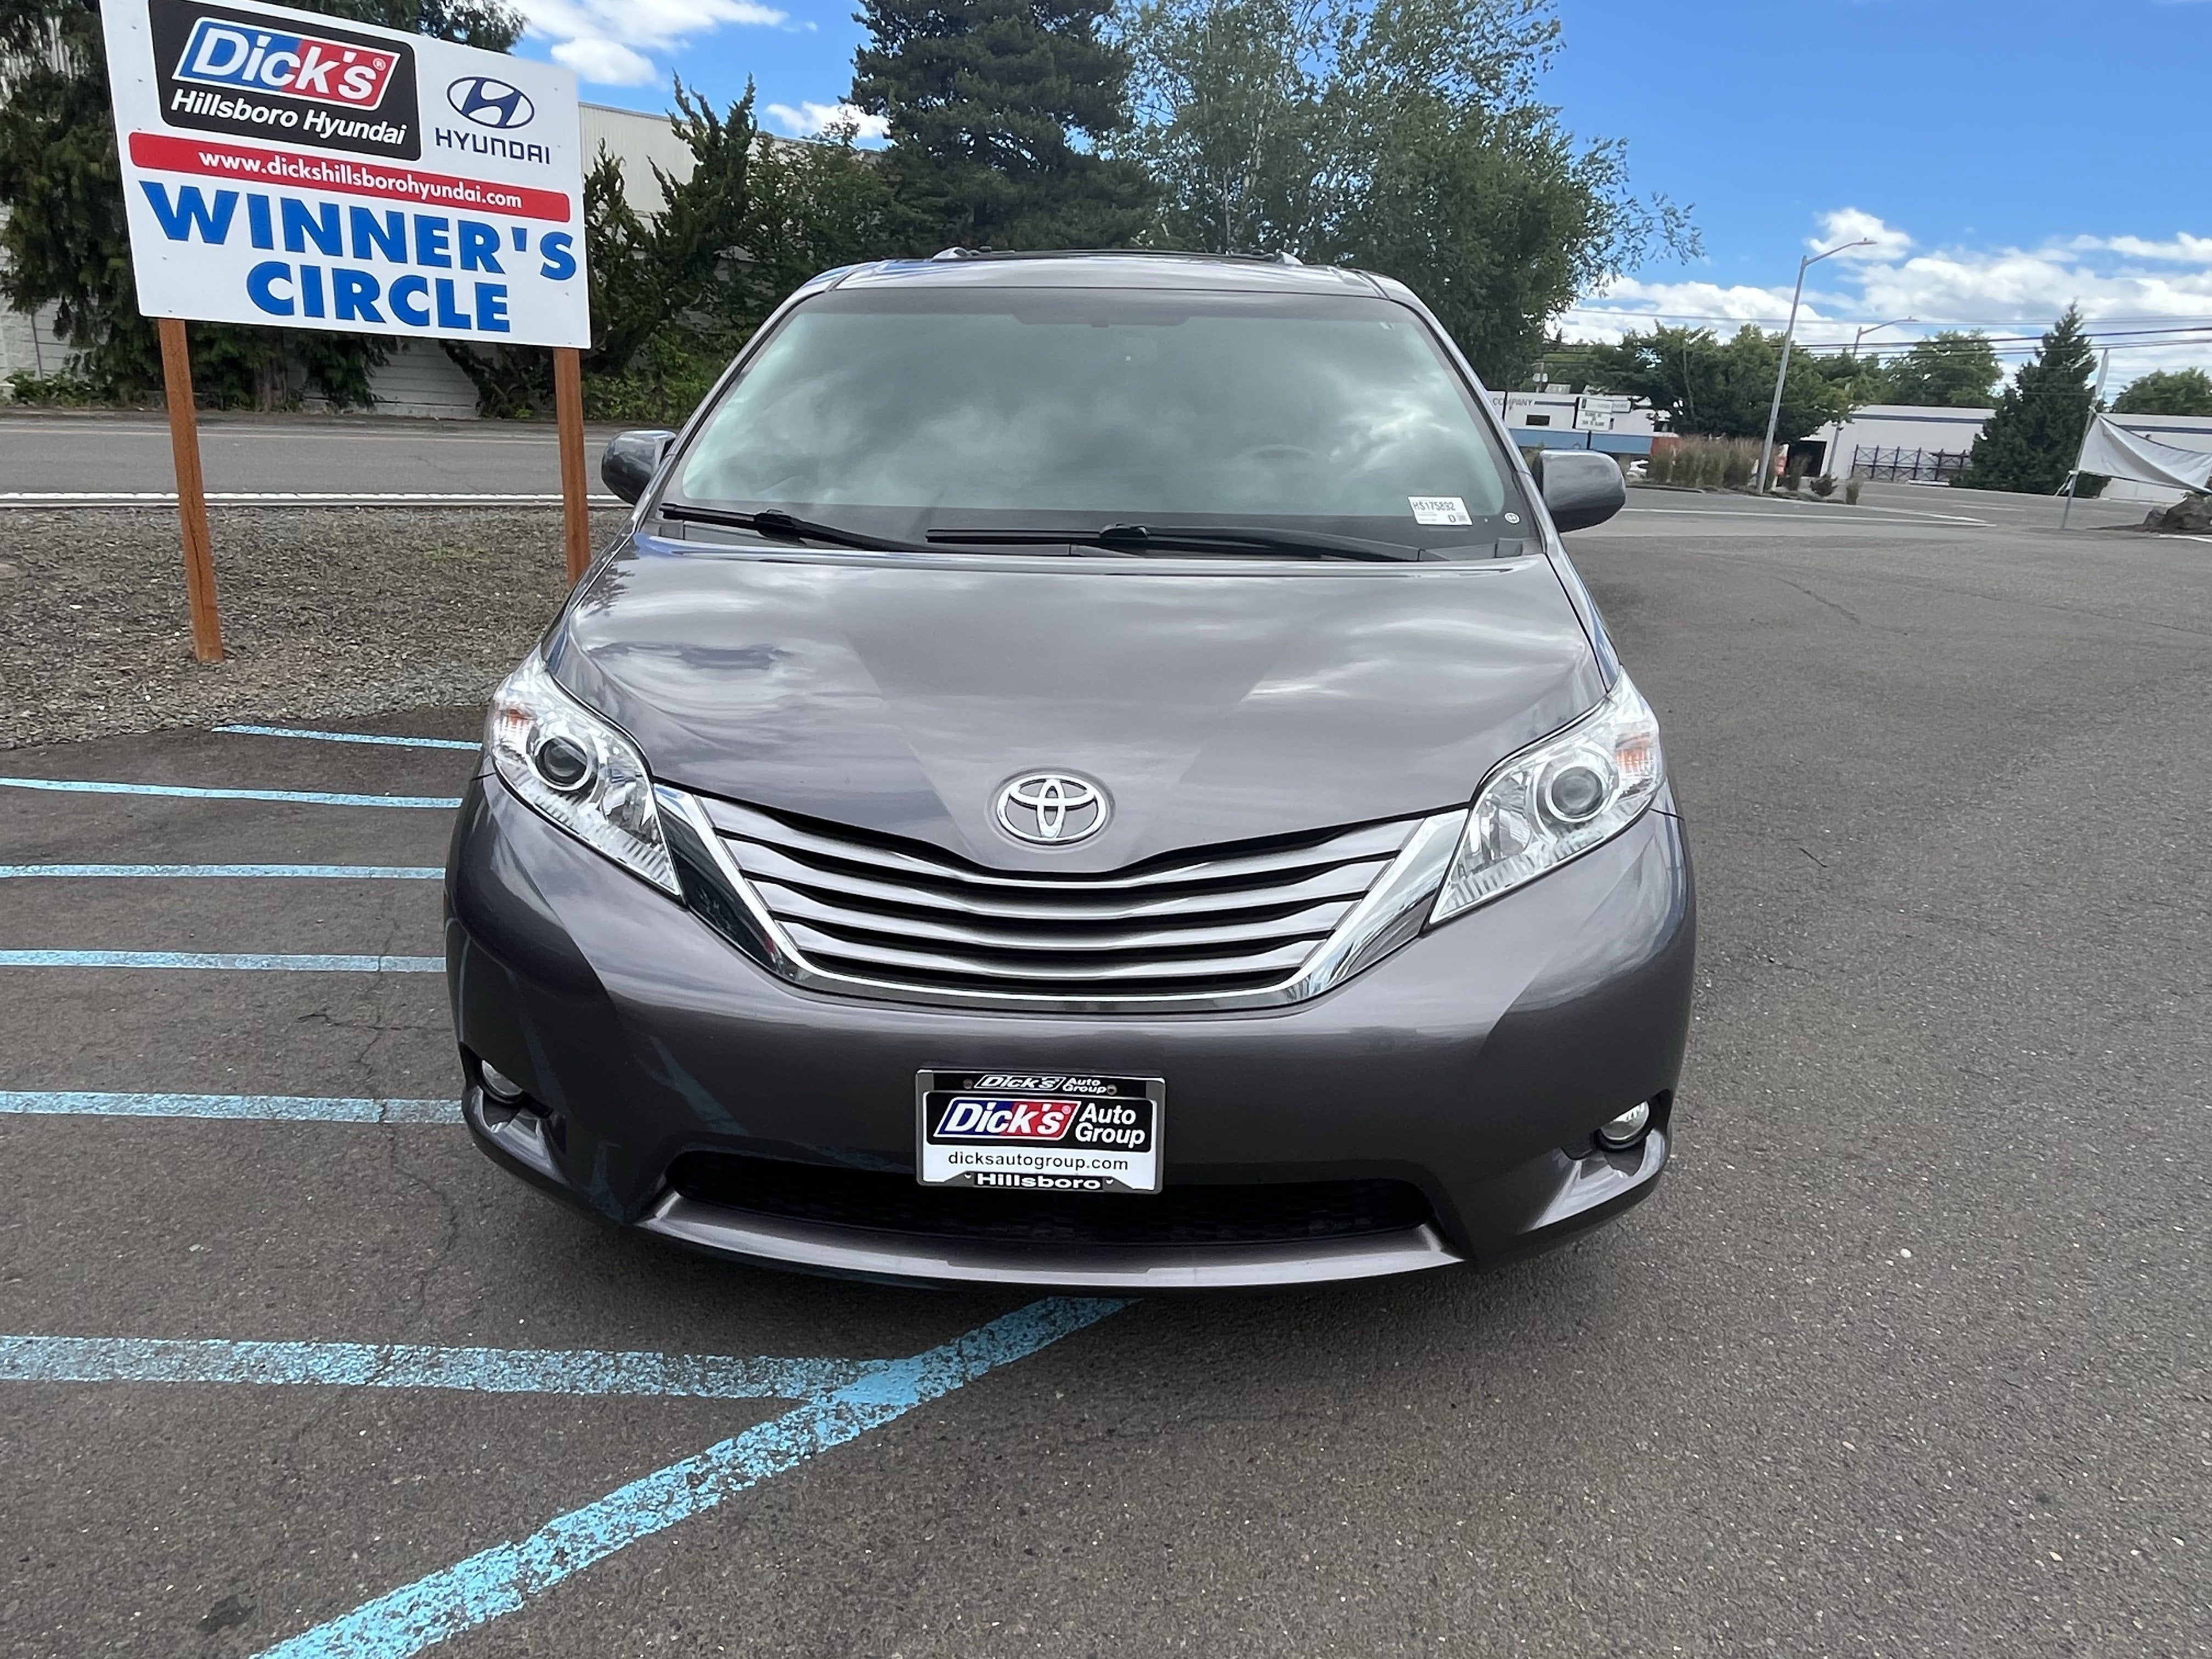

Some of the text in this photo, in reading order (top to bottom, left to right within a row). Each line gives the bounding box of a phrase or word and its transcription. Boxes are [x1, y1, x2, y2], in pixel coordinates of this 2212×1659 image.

[192, 27, 377, 100] Dick's
[171, 89, 407, 146] Hillsboro Hyundai
[436, 127, 550, 165] HYUNDAI
[199, 151, 522, 209] www.dickshillsborohyundai.com
[138, 180, 577, 281] WINNER'S
[246, 261, 510, 332] CIRCLE
[981, 1076, 1056, 1088] Dick's
[1063, 1085, 1107, 1094] Group
[1068, 1077, 1101, 1086] Auto
[944, 1102, 1064, 1135] Dick's
[1079, 1103, 1136, 1125] Auto
[1075, 1123, 1146, 1149] Group
[948, 1152, 1128, 1170] dicksautogroup.com
[977, 1173, 1101, 1190] Hillsboro
